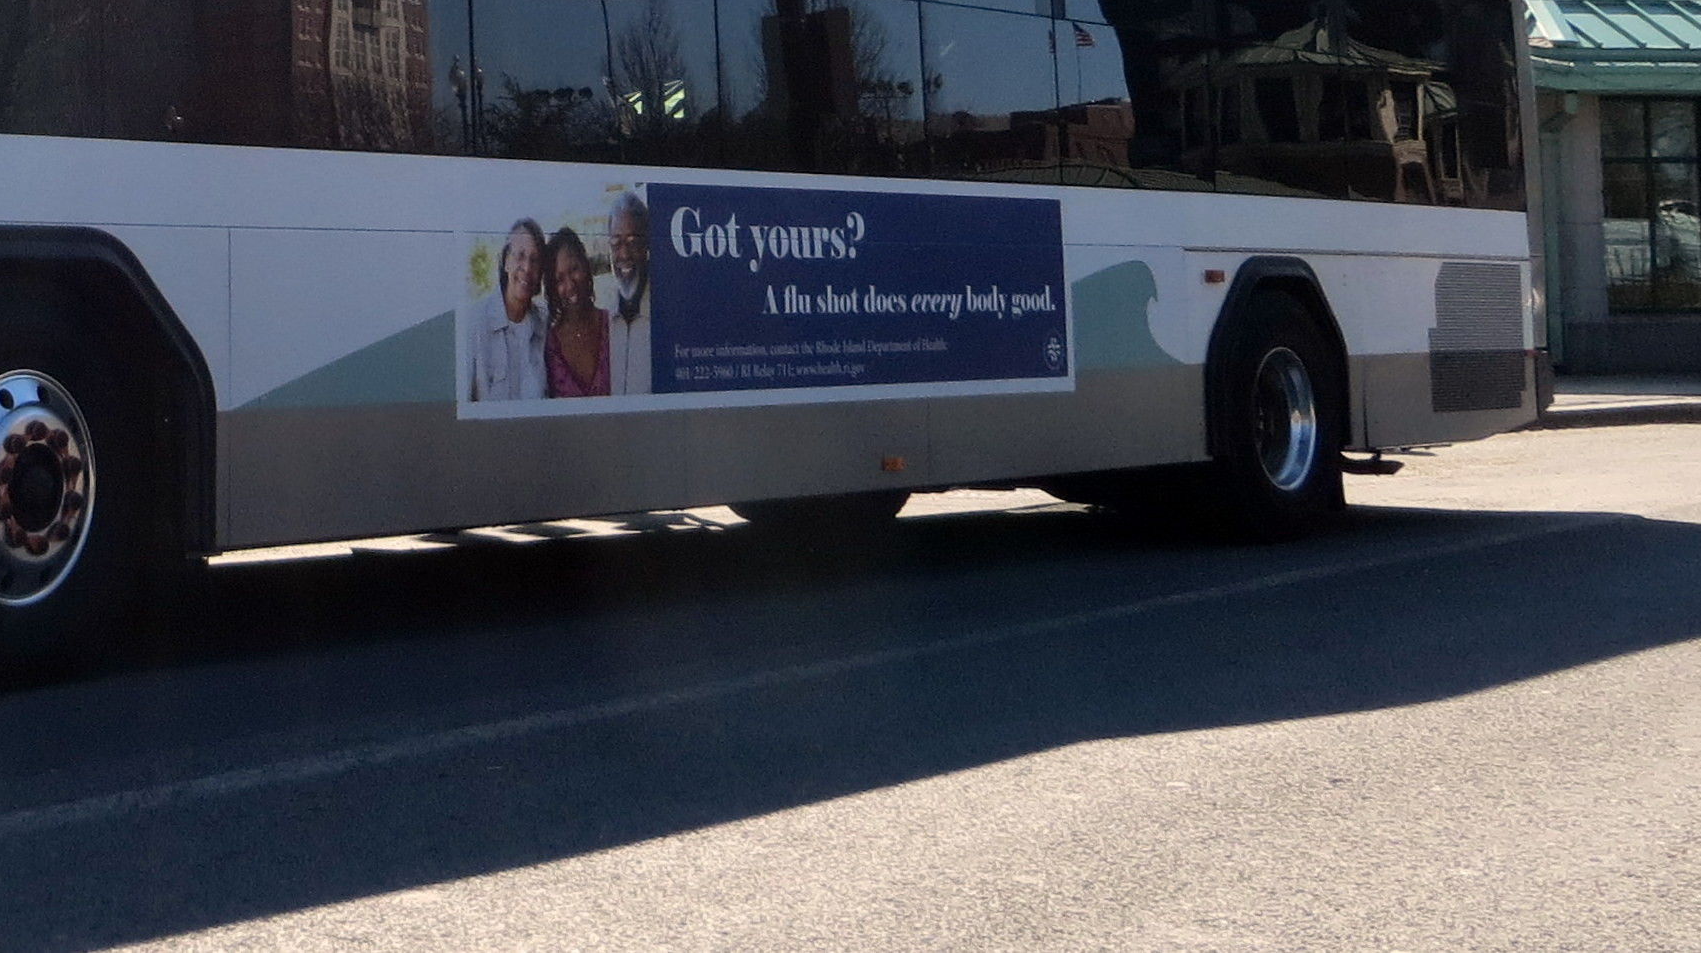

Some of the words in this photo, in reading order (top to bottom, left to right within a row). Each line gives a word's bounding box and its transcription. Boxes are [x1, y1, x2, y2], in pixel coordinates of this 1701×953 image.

[670, 206, 742, 259] Got
[749, 211, 866, 273] yours?
[761, 284, 780, 316] A
[783, 284, 812, 315] flu
[816, 284, 860, 315] shot
[863, 284, 908, 314] does
[911, 292, 963, 320] every
[965, 284, 1007, 320] body
[1011, 284, 1057, 320] good.
